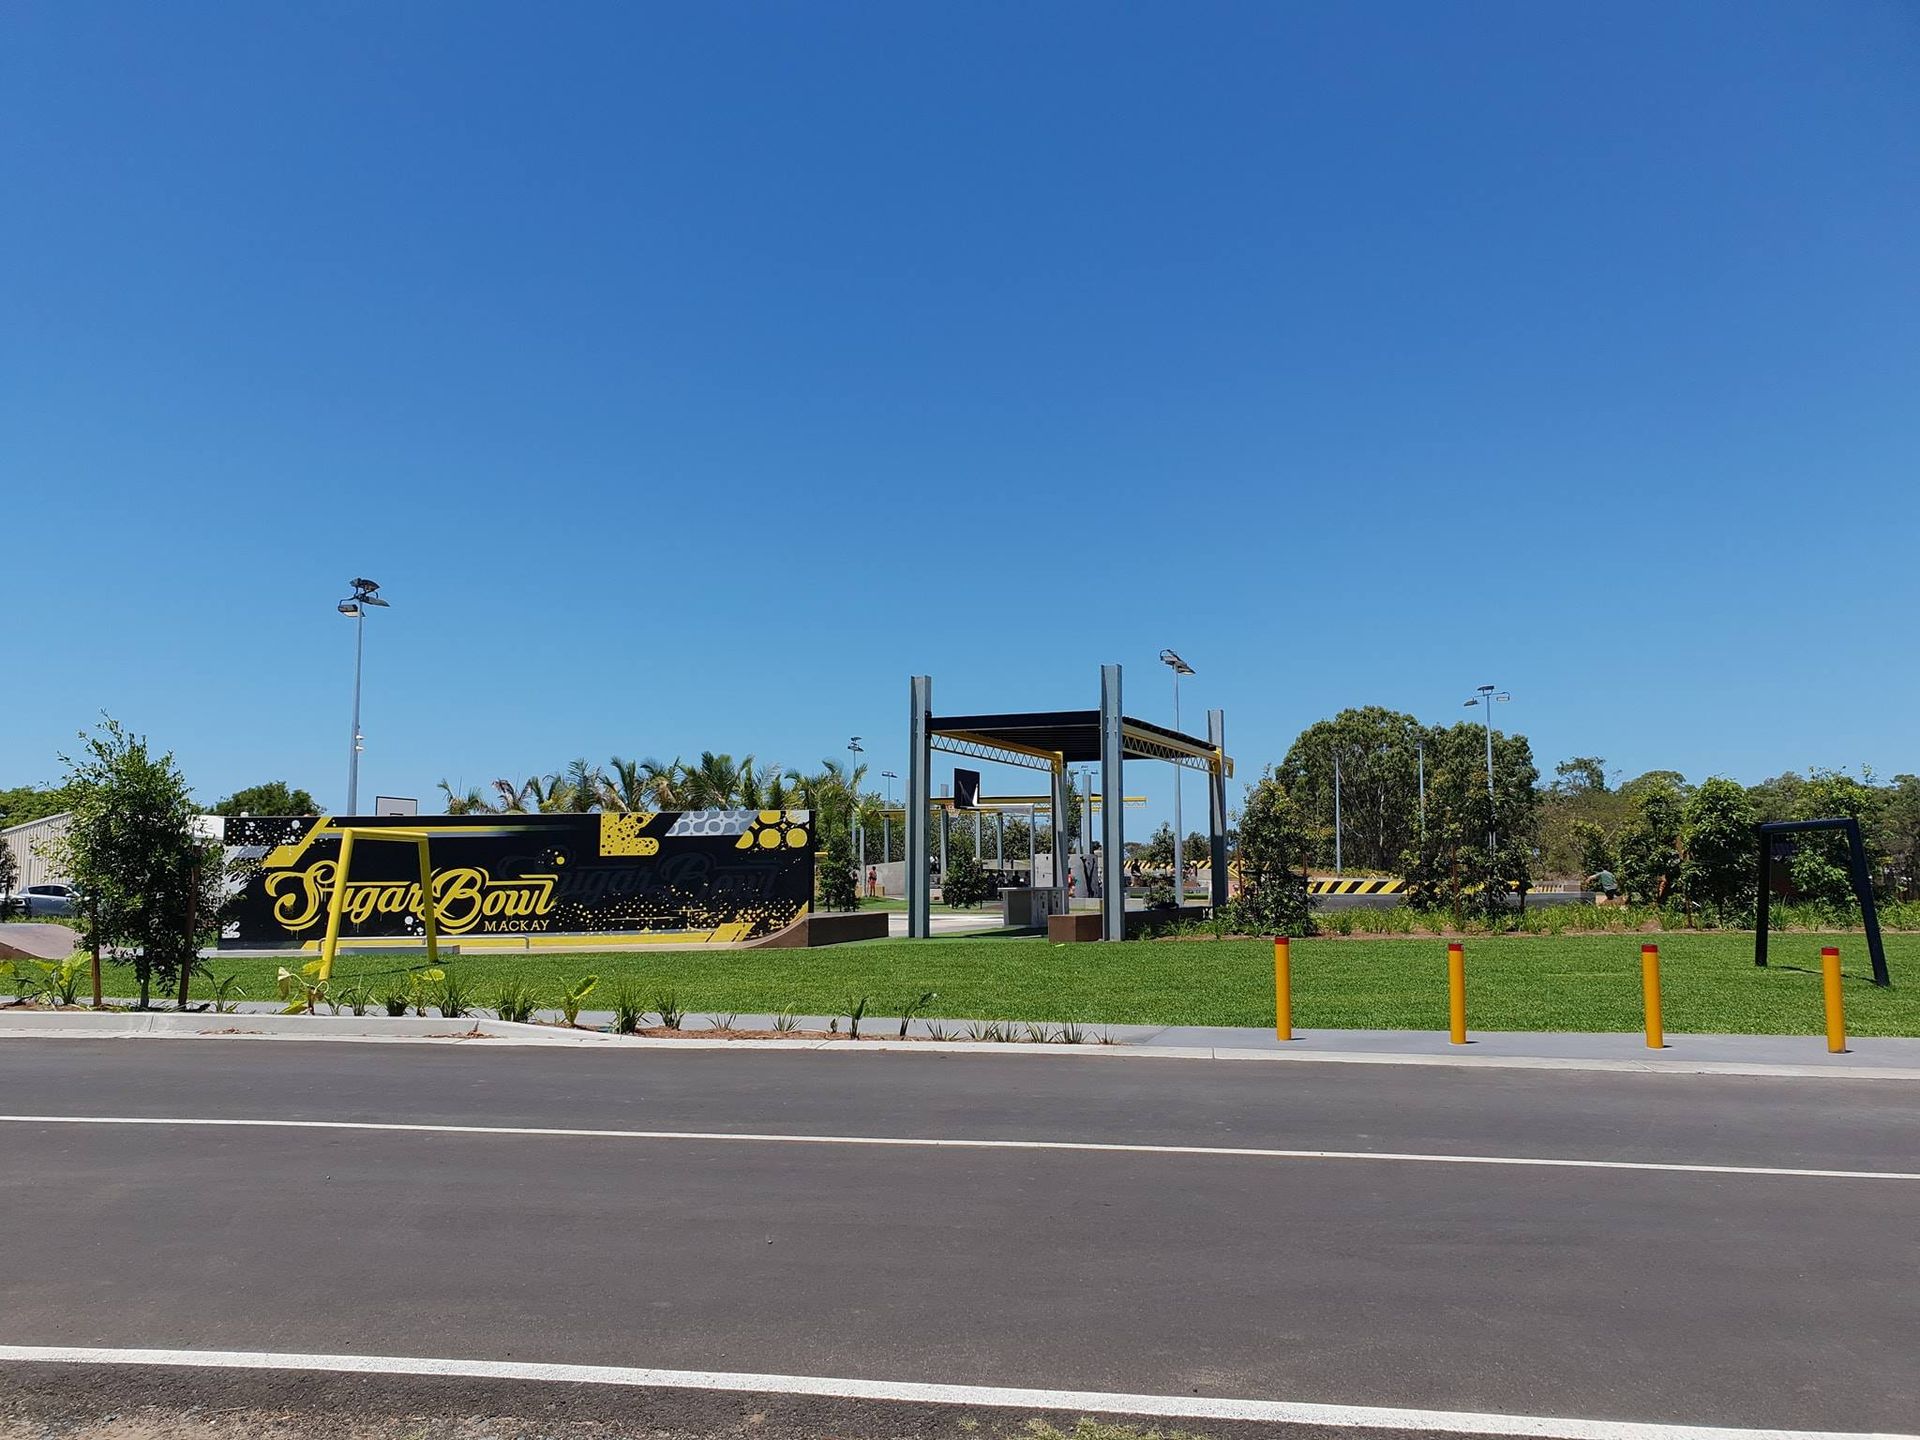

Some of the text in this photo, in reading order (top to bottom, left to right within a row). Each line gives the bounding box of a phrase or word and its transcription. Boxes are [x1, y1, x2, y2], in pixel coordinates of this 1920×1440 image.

[264, 860, 558, 934] Sugar Bowl
[484, 920, 549, 932] MACKAY
